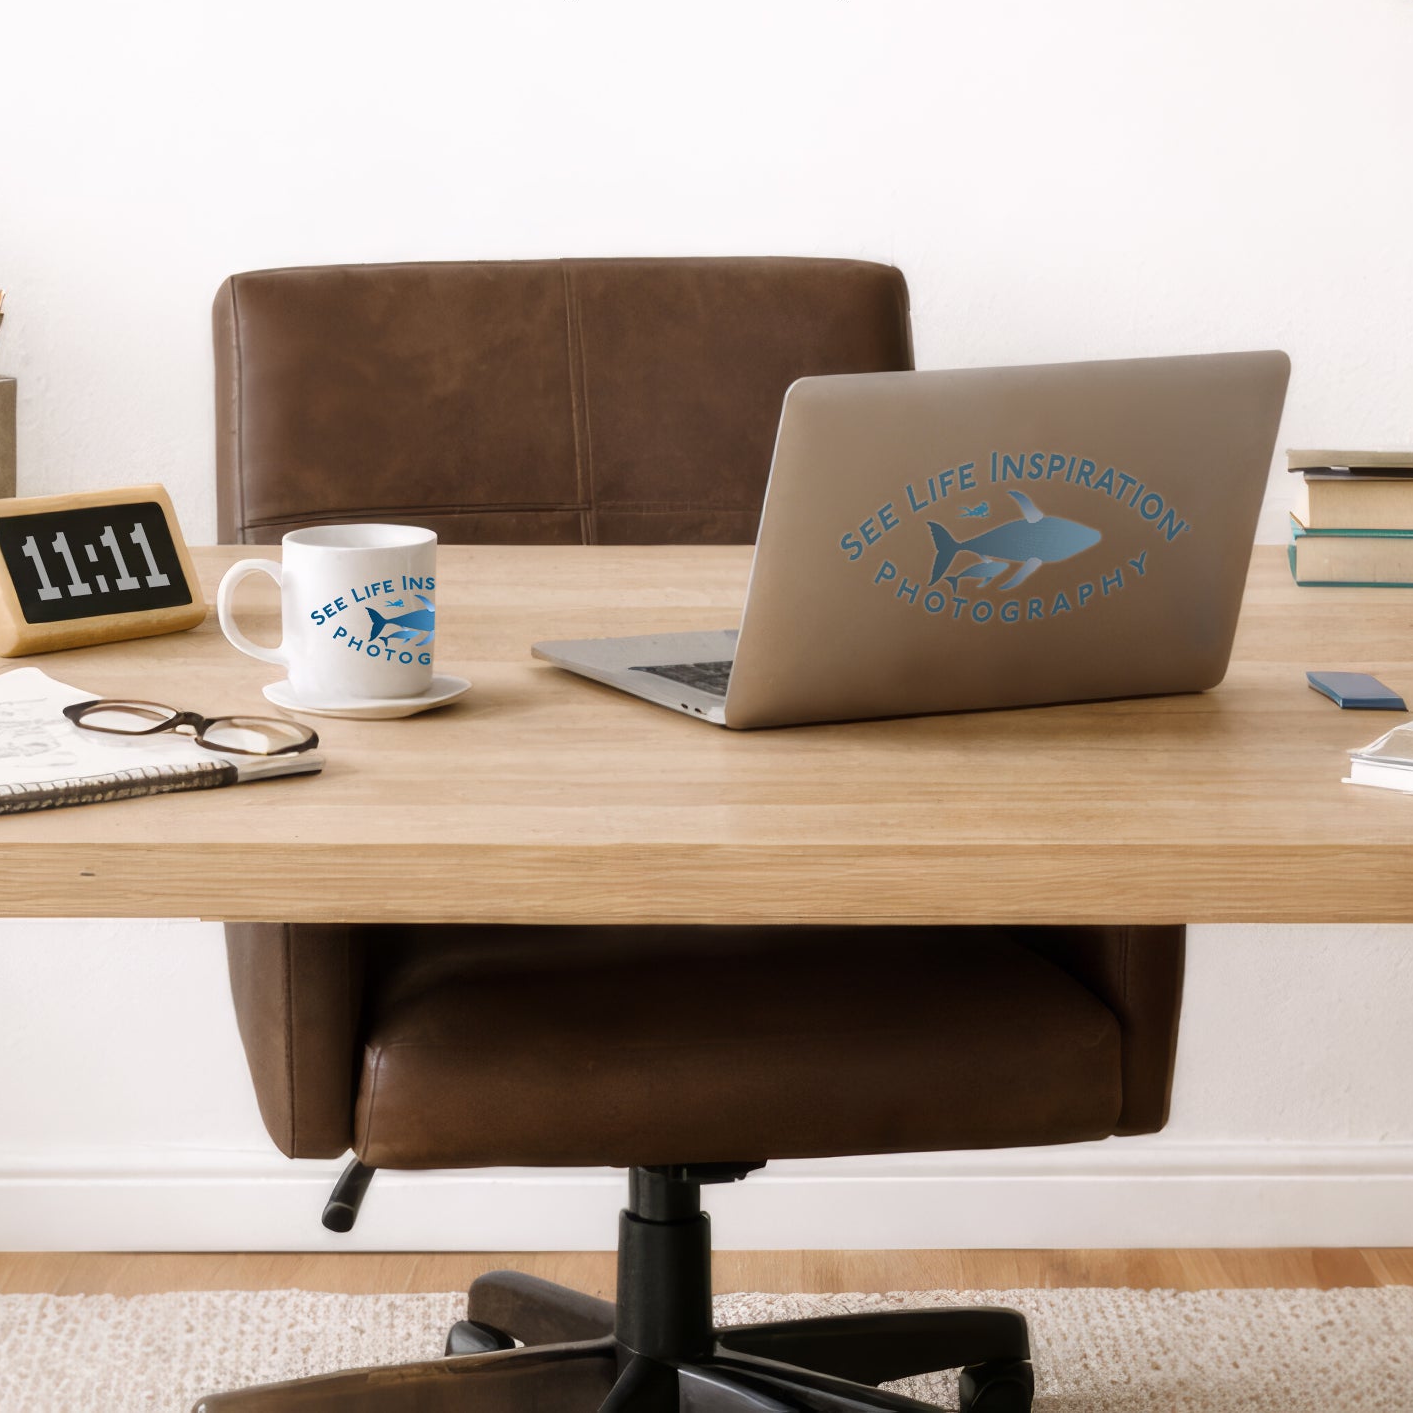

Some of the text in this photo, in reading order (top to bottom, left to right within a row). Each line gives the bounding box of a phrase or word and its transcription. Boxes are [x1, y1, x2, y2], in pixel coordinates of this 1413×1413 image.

[840, 503, 900, 561] SEE
[905, 462, 977, 513] LIFE
[21, 522, 171, 601] 11:11
[873, 550, 1148, 623] PHOTOGRAPHY
[310, 596, 348, 625] SEE
[351, 579, 395, 603] LIFE
[332, 626, 431, 666] PHOTOG
